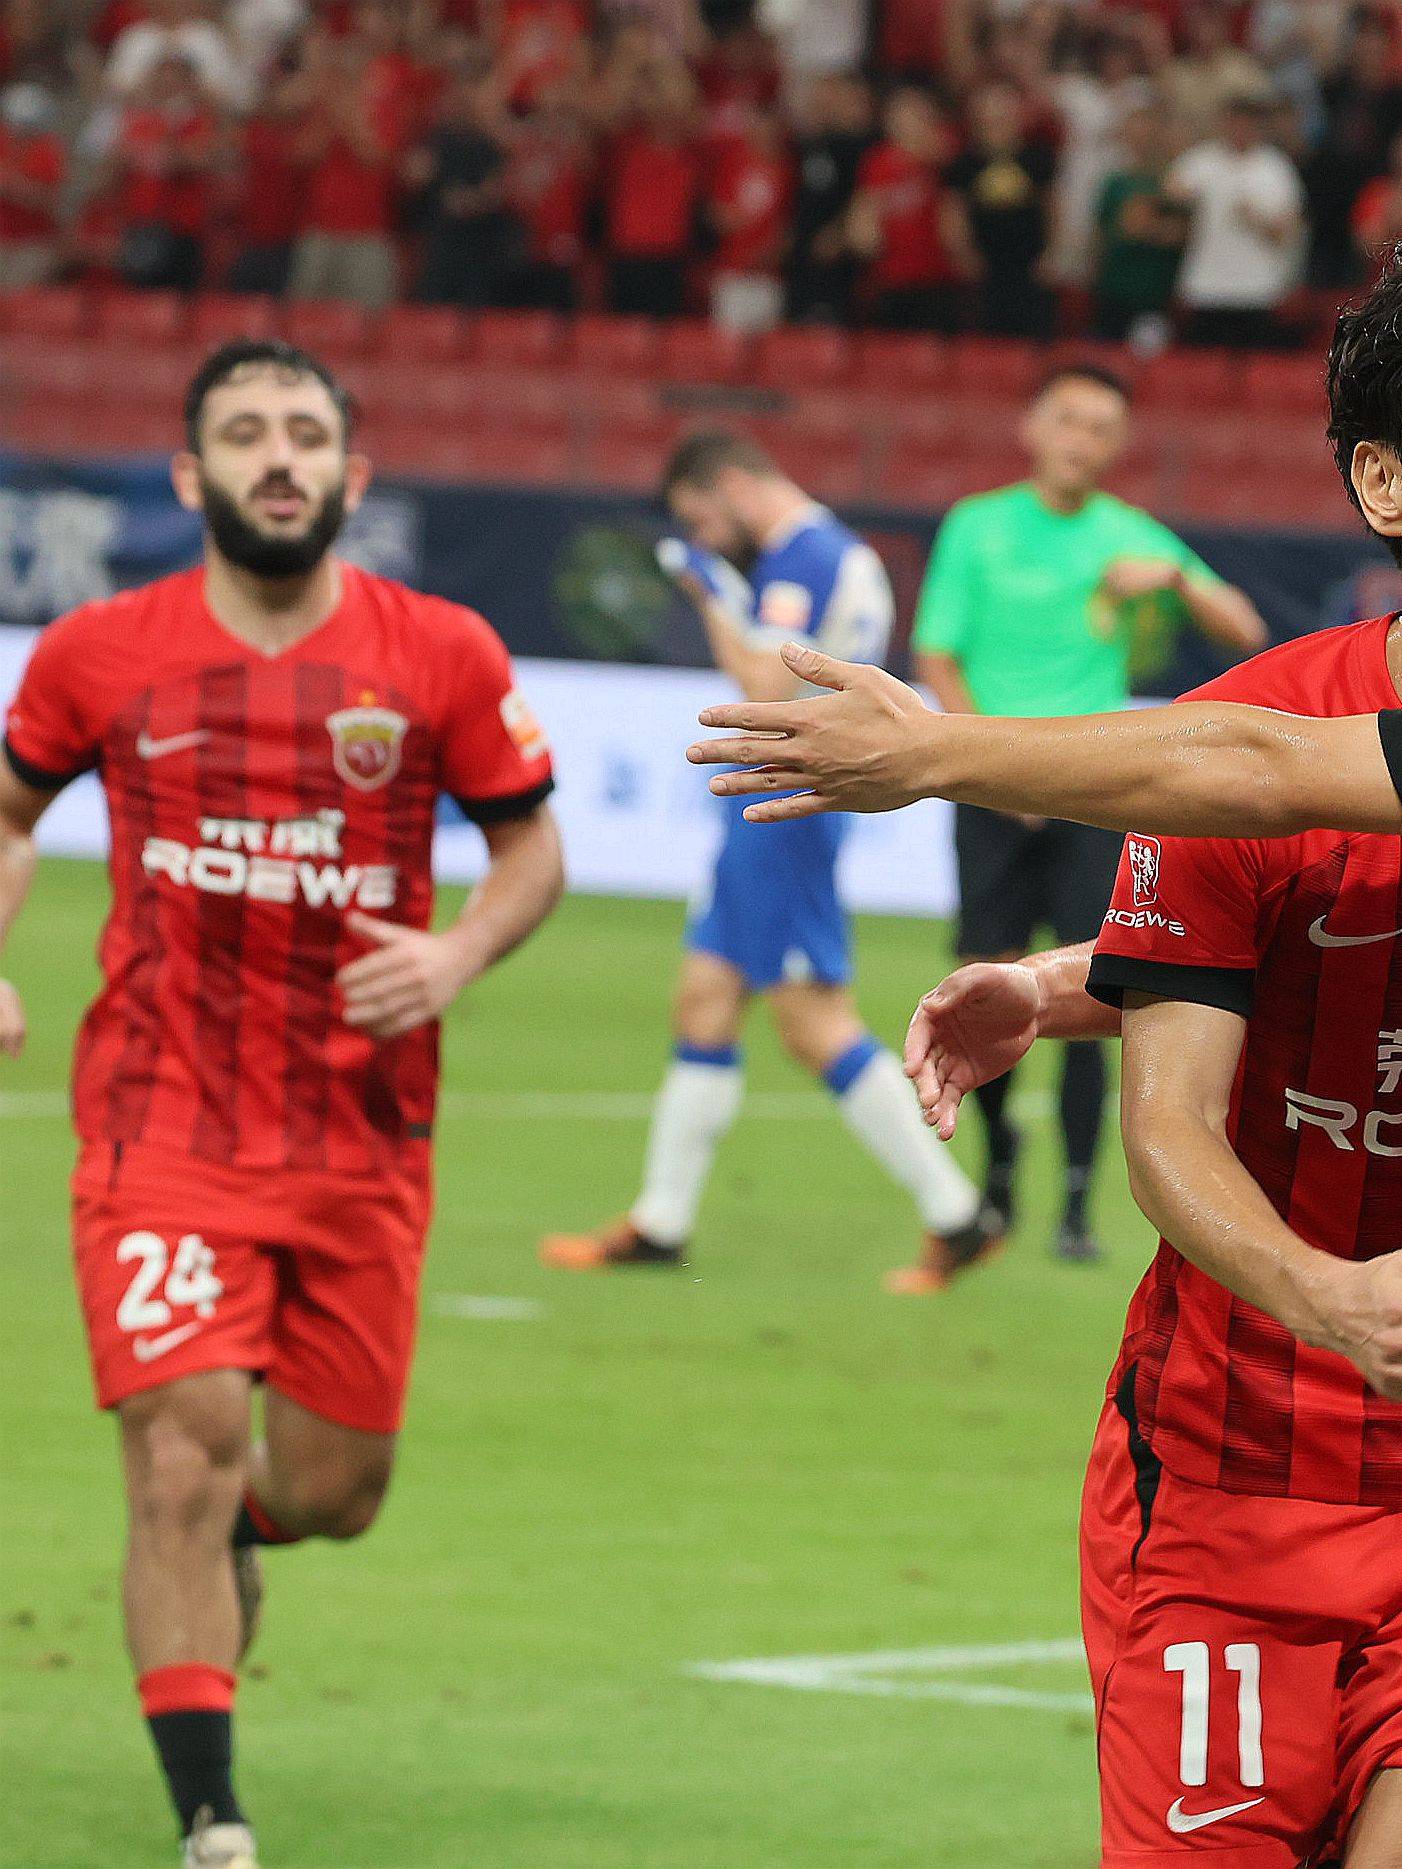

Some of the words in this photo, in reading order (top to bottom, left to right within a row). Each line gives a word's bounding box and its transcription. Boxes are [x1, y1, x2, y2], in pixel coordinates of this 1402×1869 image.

[1104, 908, 1186, 937] ROEWE
[116, 1229, 226, 1333] 24
[1163, 1640, 1265, 1788] 11
